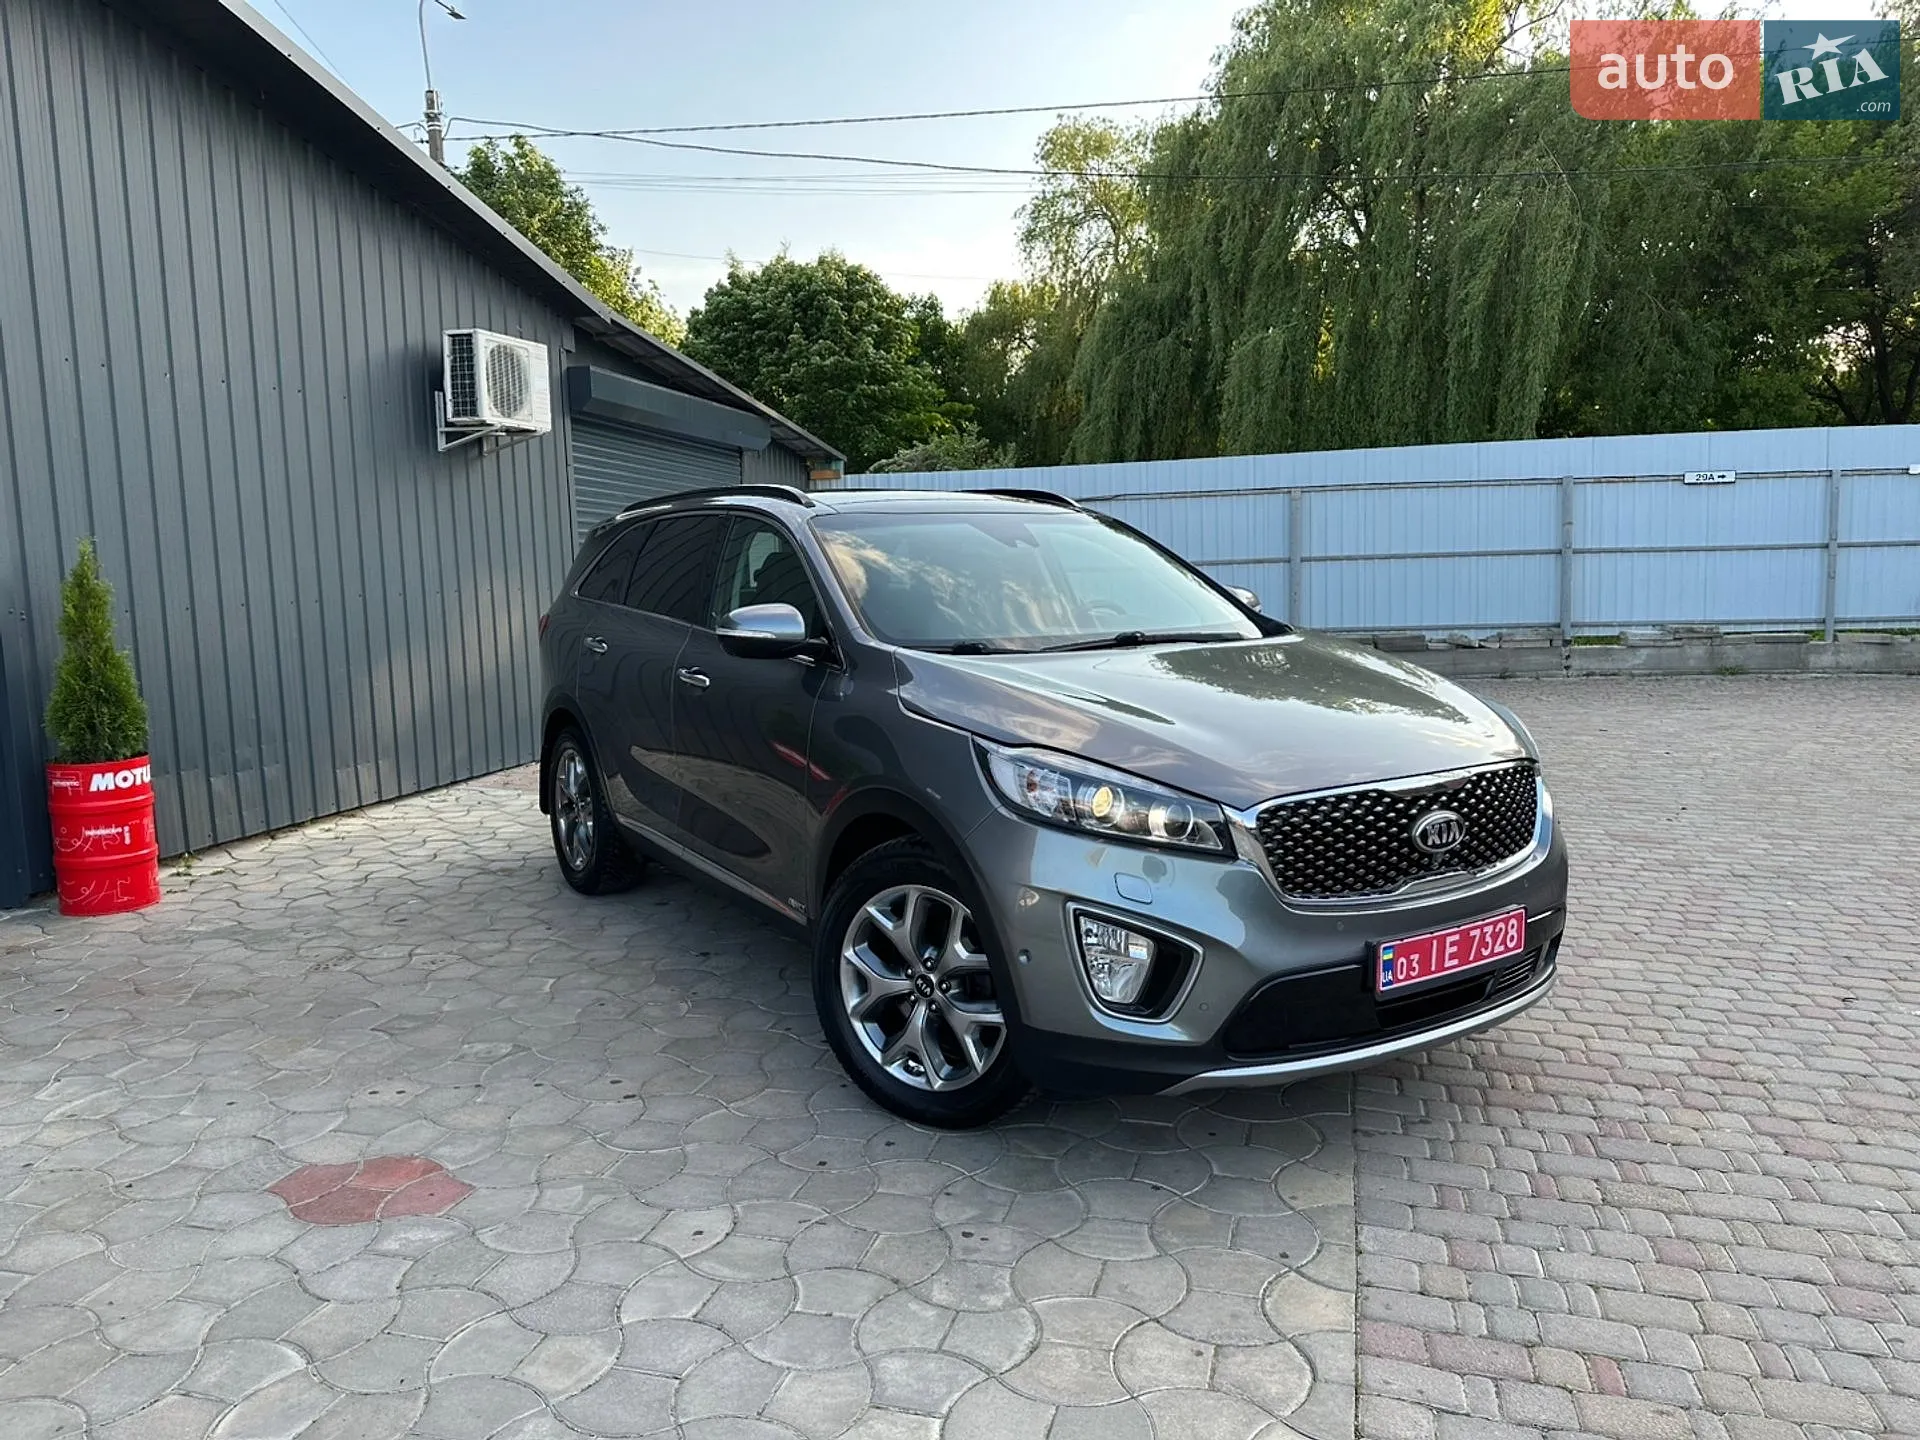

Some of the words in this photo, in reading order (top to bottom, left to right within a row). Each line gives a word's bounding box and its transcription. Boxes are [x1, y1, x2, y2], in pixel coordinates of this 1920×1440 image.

[1425, 822, 1461, 846] KIA
[1397, 953, 1420, 980] 03
[1430, 934, 1460, 972] IE
[1468, 918, 1518, 961] 7328
